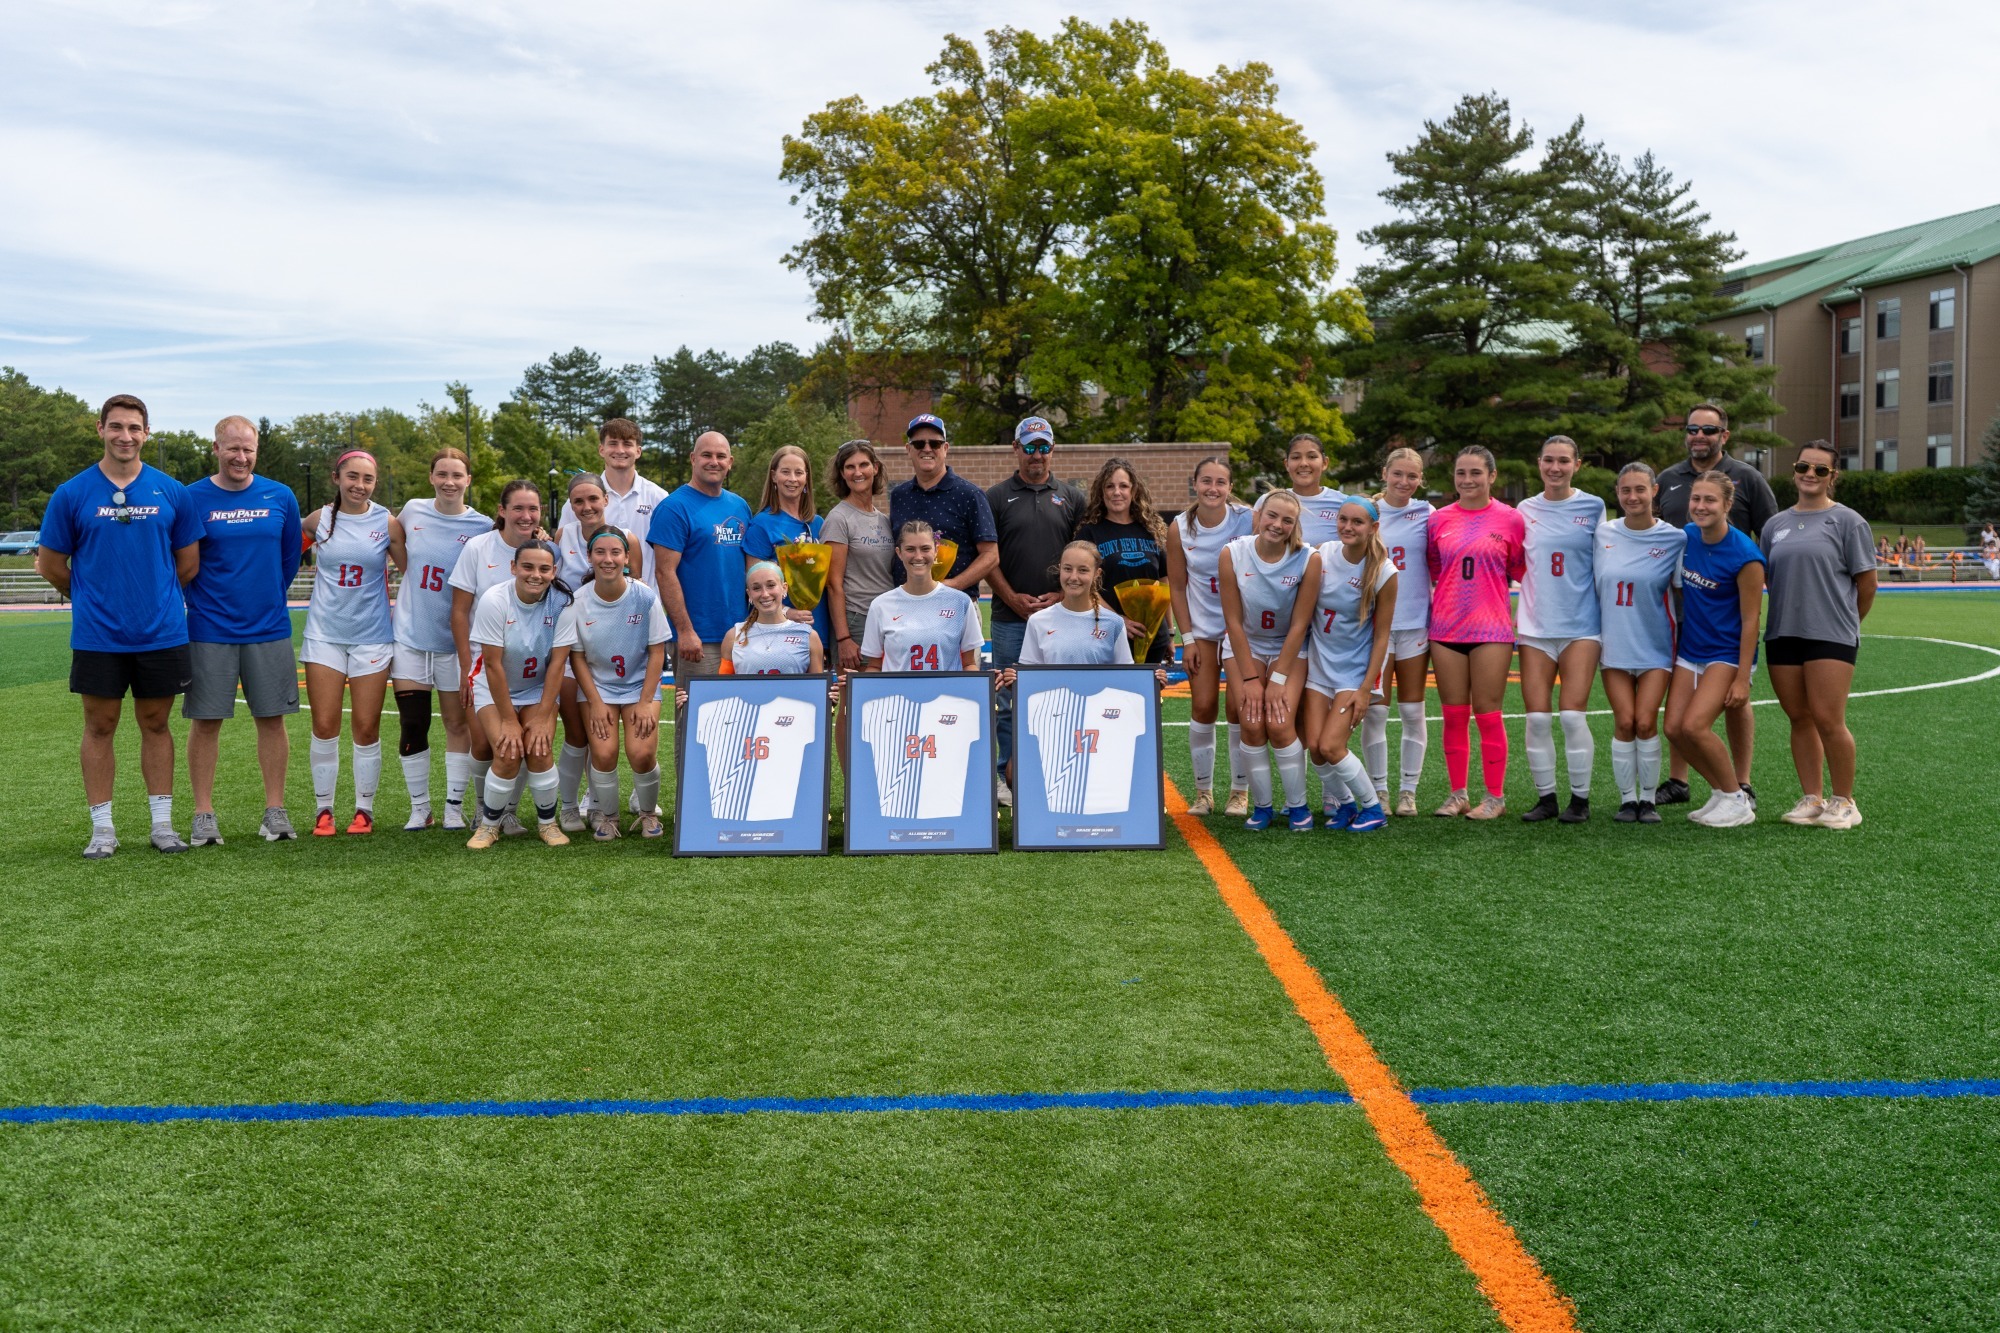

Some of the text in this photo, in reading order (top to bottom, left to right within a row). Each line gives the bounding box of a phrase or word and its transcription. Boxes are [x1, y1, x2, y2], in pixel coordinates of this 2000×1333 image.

[126, 506, 158, 515] PALTZ
[236, 509, 270, 519] PALTZ
[715, 525, 734, 535] NEW
[717, 533, 742, 543] PALTZ
[1386, 546, 1406, 571] 2
[1462, 556, 1475, 581] 0
[1551, 551, 1565, 577] 8
[338, 564, 364, 587] 13
[420, 564, 445, 592] 15
[1690, 572, 1718, 590] PALTZ
[1616, 580, 1634, 606] 11
[1261, 610, 1276, 630] 6
[1323, 608, 1337, 634] 7
[523, 656, 538, 679] 2
[611, 655, 625, 678] 3
[910, 643, 939, 671] 24
[743, 736, 770, 761] 16
[905, 734, 937, 759] 24
[1073, 729, 1100, 754] 17
